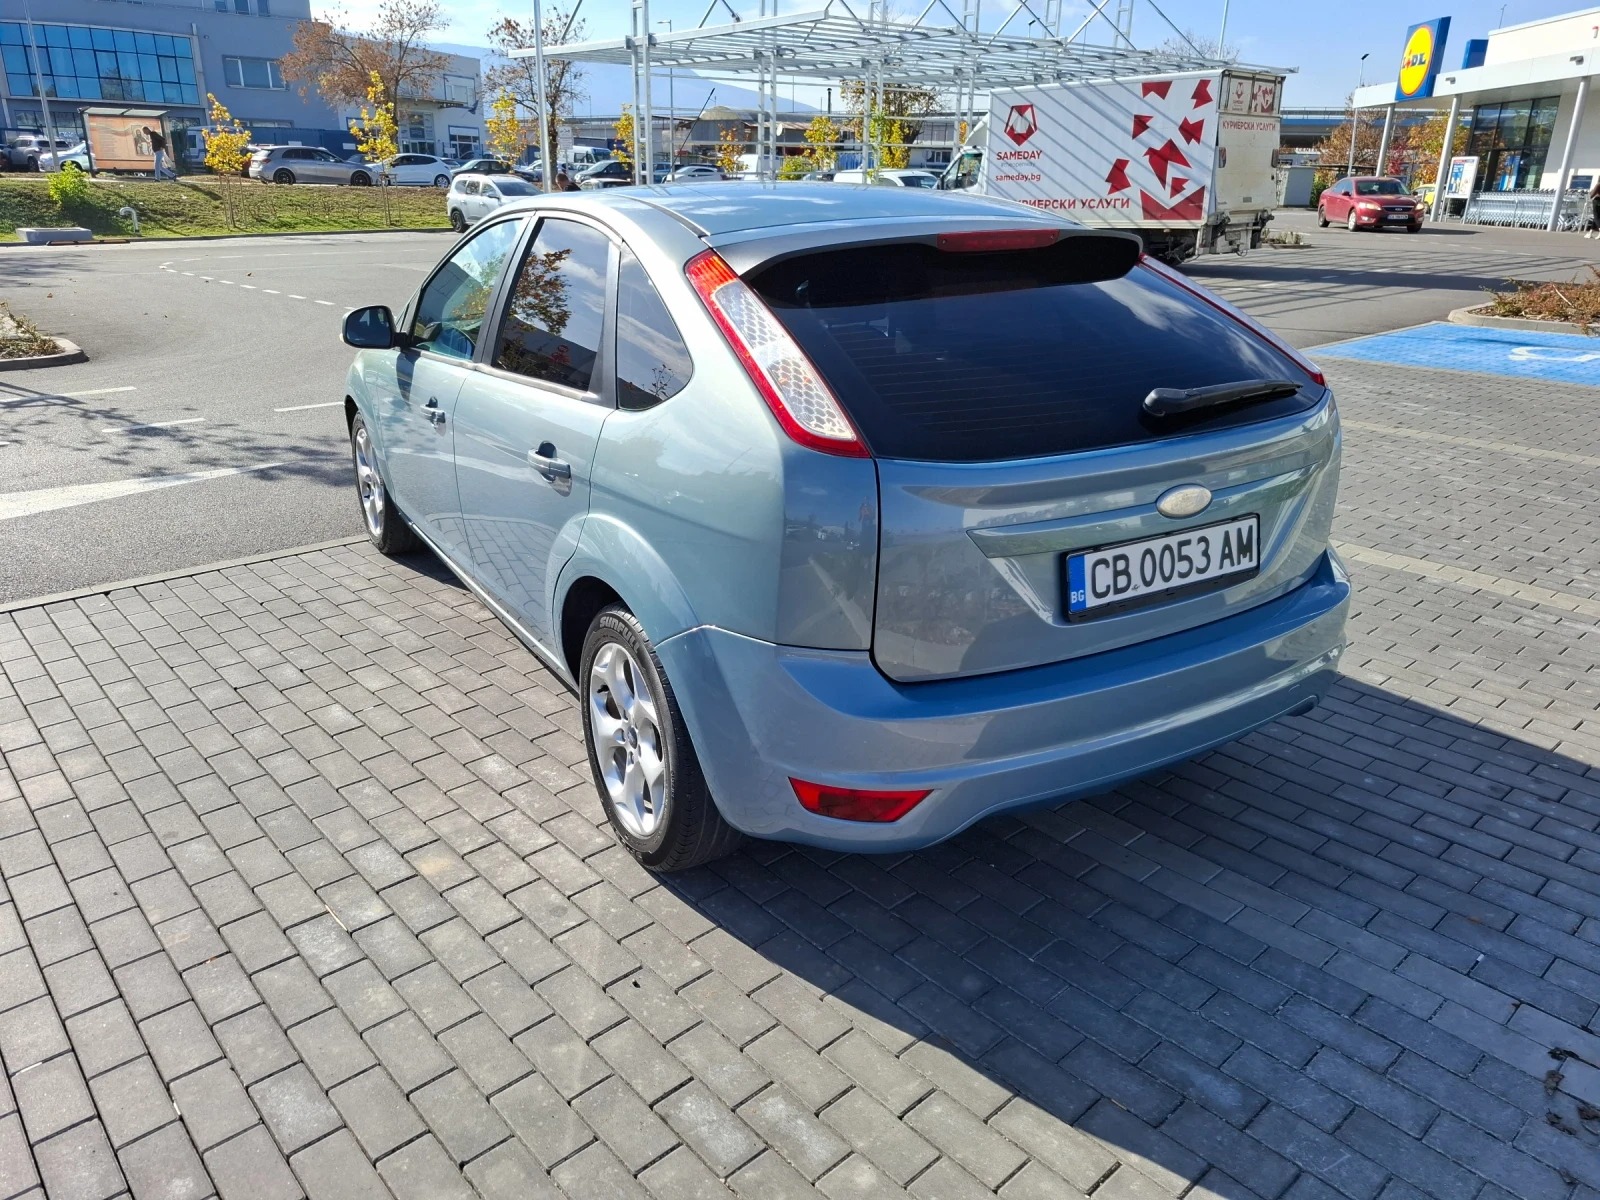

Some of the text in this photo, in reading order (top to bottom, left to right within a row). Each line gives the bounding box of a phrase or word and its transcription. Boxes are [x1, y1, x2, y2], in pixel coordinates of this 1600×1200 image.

[1222, 120, 1277, 132] КУРИЕРСКИ УСЛУГИ
[996, 150, 1043, 161] SAMEDAY
[995, 173, 1041, 182] sameday.bg
[1080, 198, 1131, 210] УСЛУГИ
[1091, 524, 1254, 600] CB 0053 AM
[1070, 589, 1086, 605] BG
